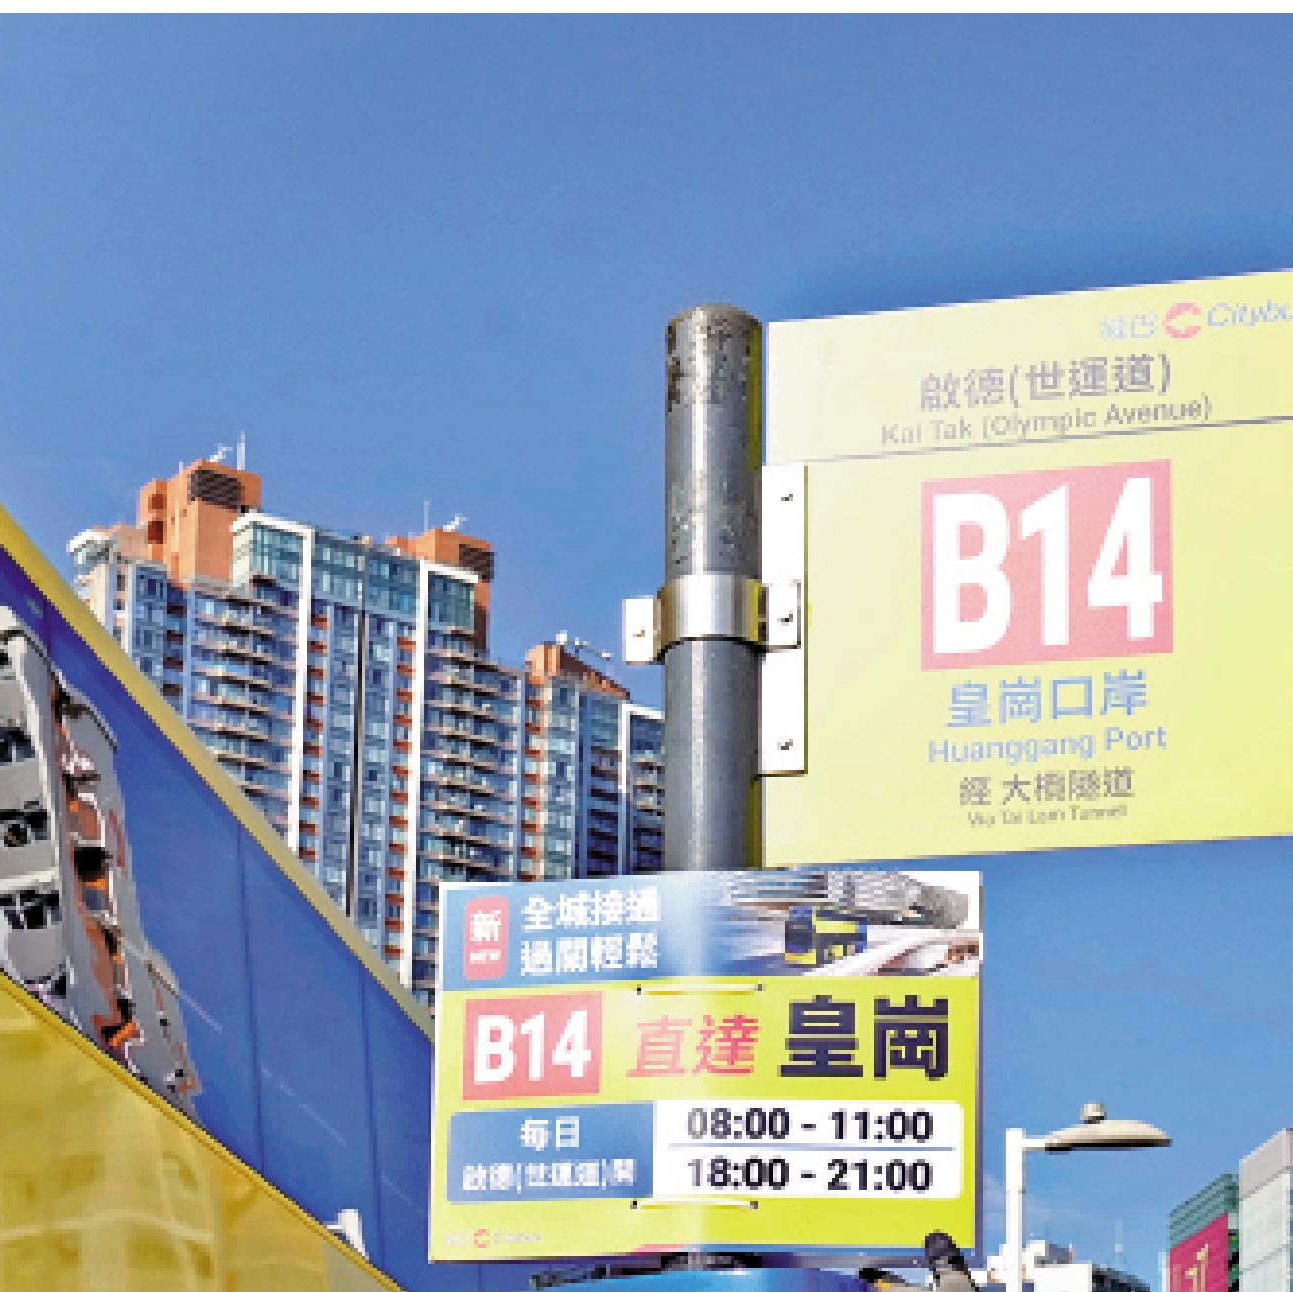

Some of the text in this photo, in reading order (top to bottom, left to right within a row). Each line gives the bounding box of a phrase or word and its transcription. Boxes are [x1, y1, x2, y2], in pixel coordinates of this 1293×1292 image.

[881, 394, 1213, 448] Kai Tak (Olympic Avenue)
[932, 477, 1163, 654] B14
[945, 670, 1148, 729] 皇崗口岸
[929, 724, 1167, 766] Huanggang Port
[469, 909, 503, 943] 新
[473, 1010, 592, 1085] B14
[626, 995, 950, 1081] 直達 皇崗
[520, 1117, 581, 1152] 每日
[687, 1107, 791, 1140] 08:00
[830, 1109, 934, 1143] 11:00
[687, 1158, 790, 1190] 18:00
[827, 1158, 933, 1191] 21:00
